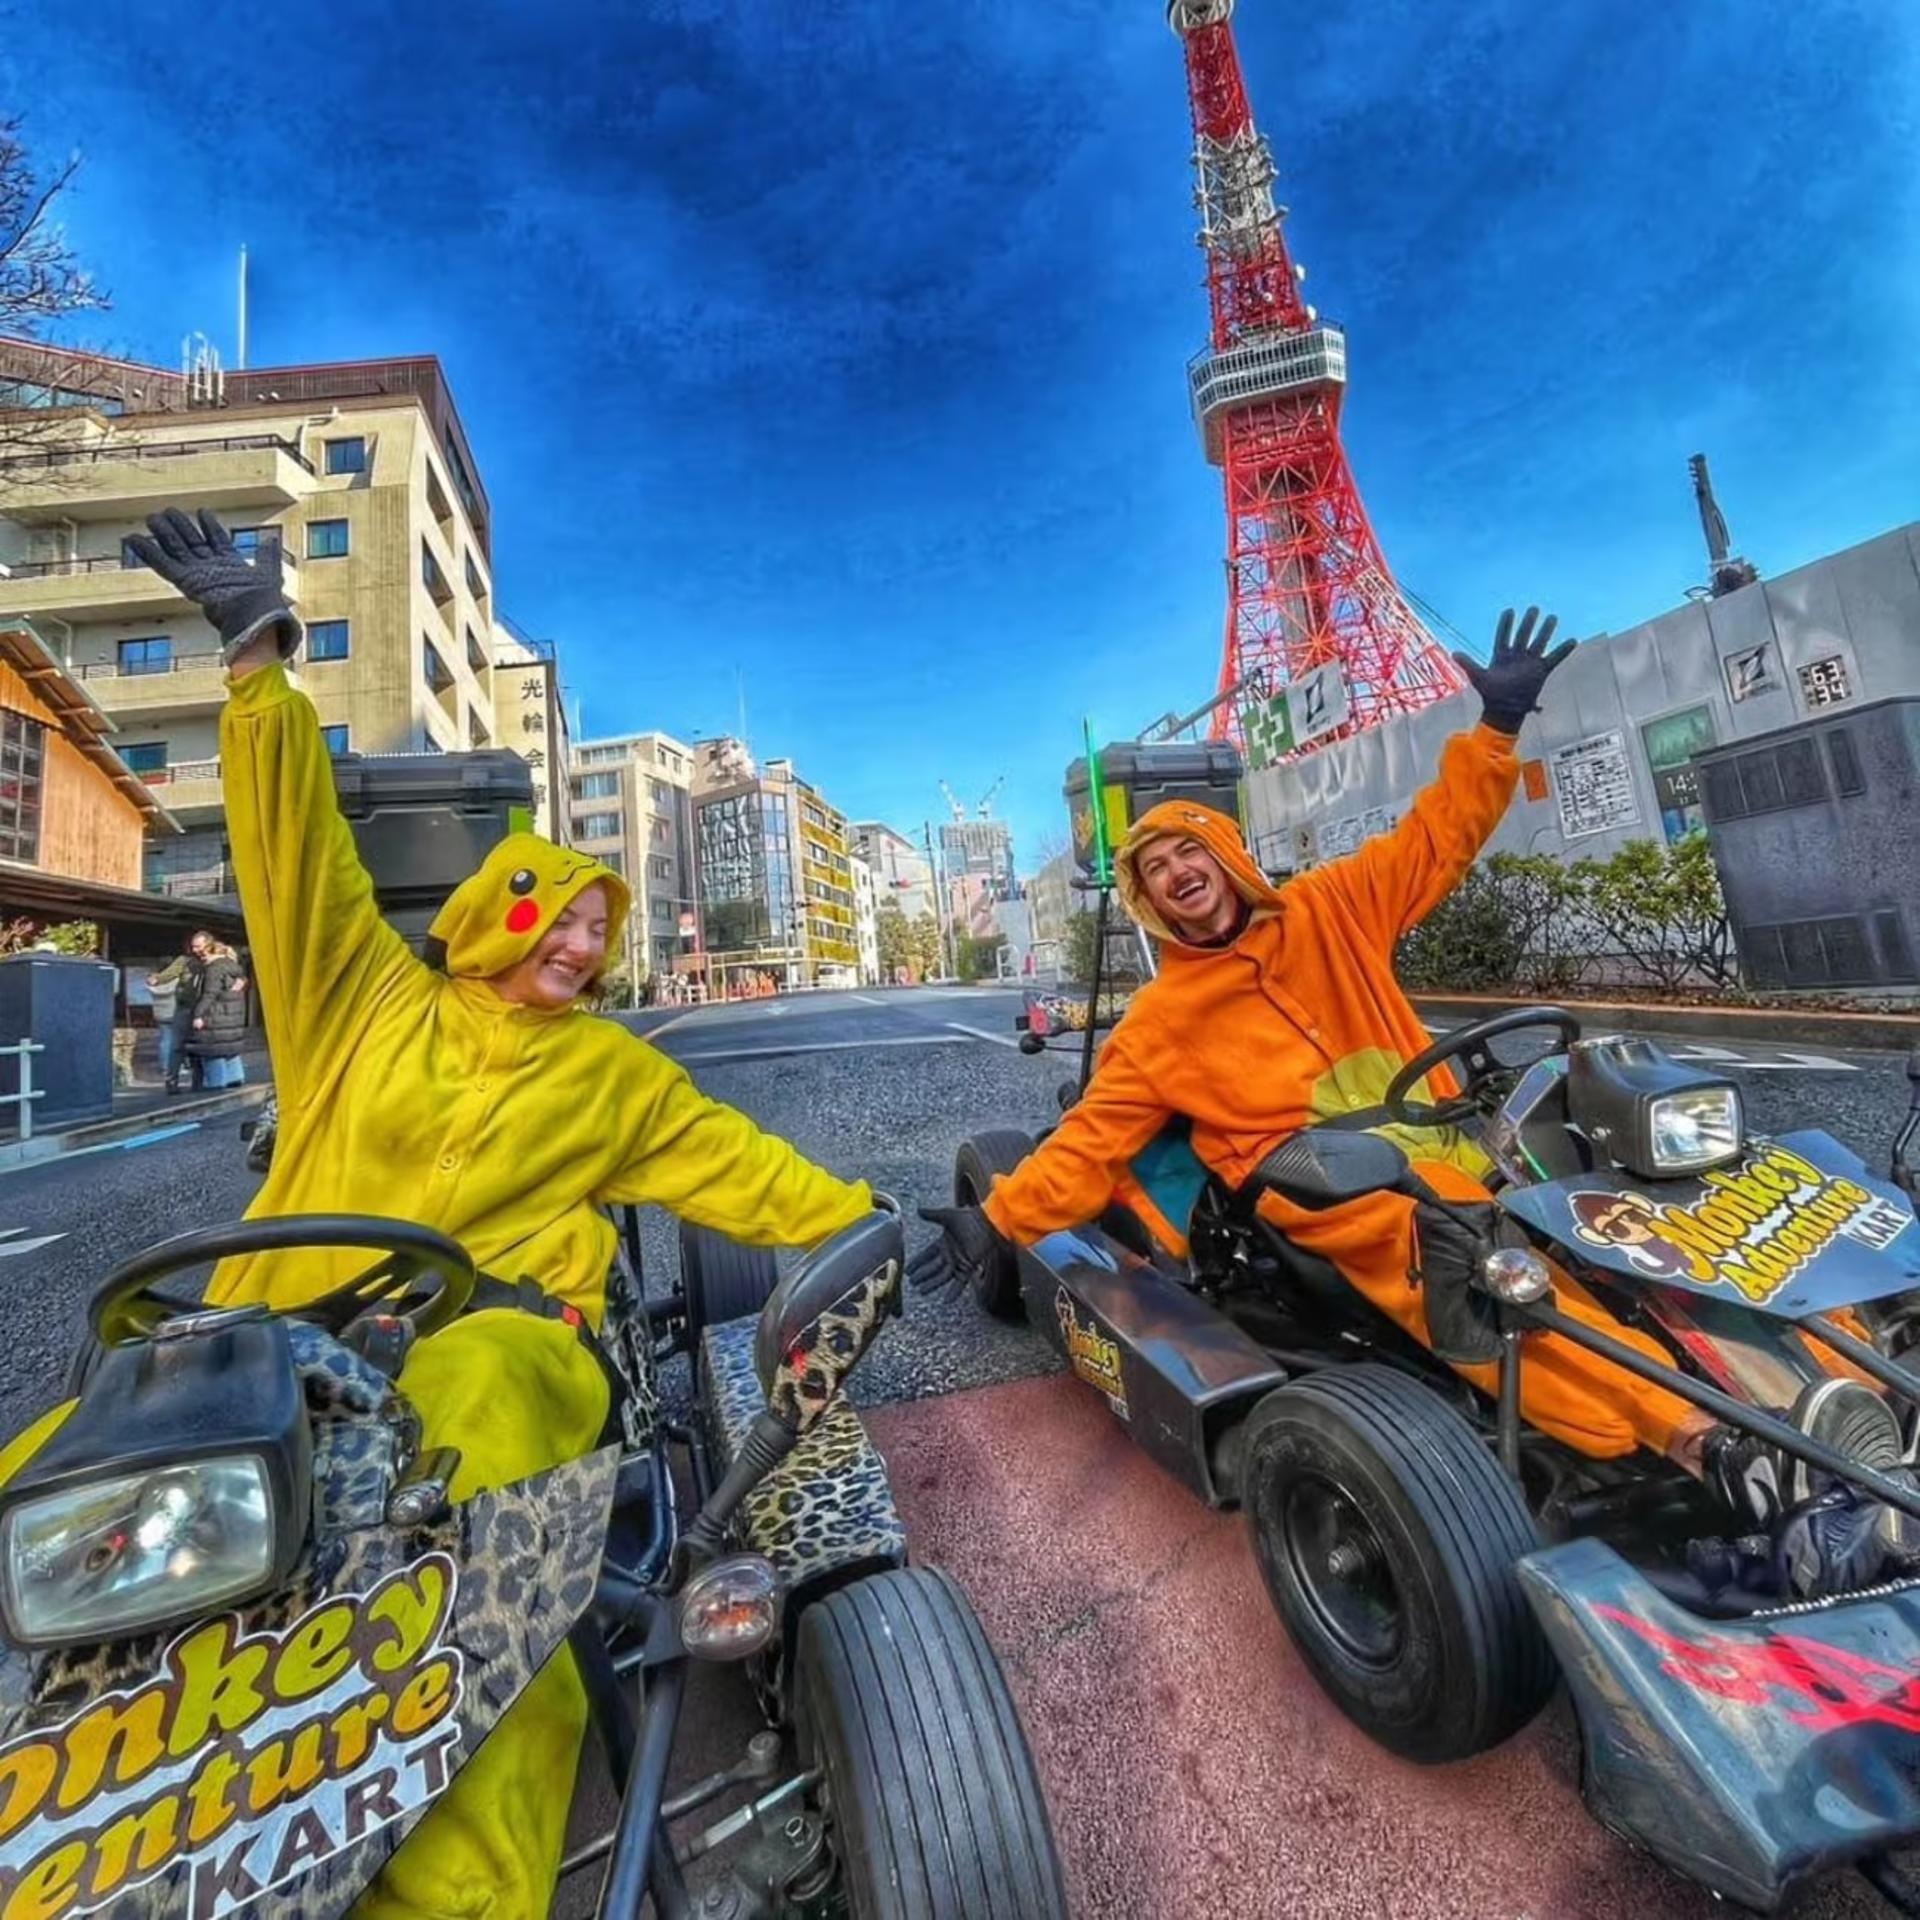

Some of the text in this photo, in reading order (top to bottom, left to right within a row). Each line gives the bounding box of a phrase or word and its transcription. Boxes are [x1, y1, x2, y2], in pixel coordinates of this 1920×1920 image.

[1811, 660, 1841, 686] 63
[1815, 681, 1845, 706] 34
[1644, 1146, 1825, 1284] Monkey
[1717, 1176, 1871, 1303] Adventure
[1850, 1201, 1912, 1249] KART
[0, 1658, 454, 1920] enture
[195, 1735, 449, 1920] KART
